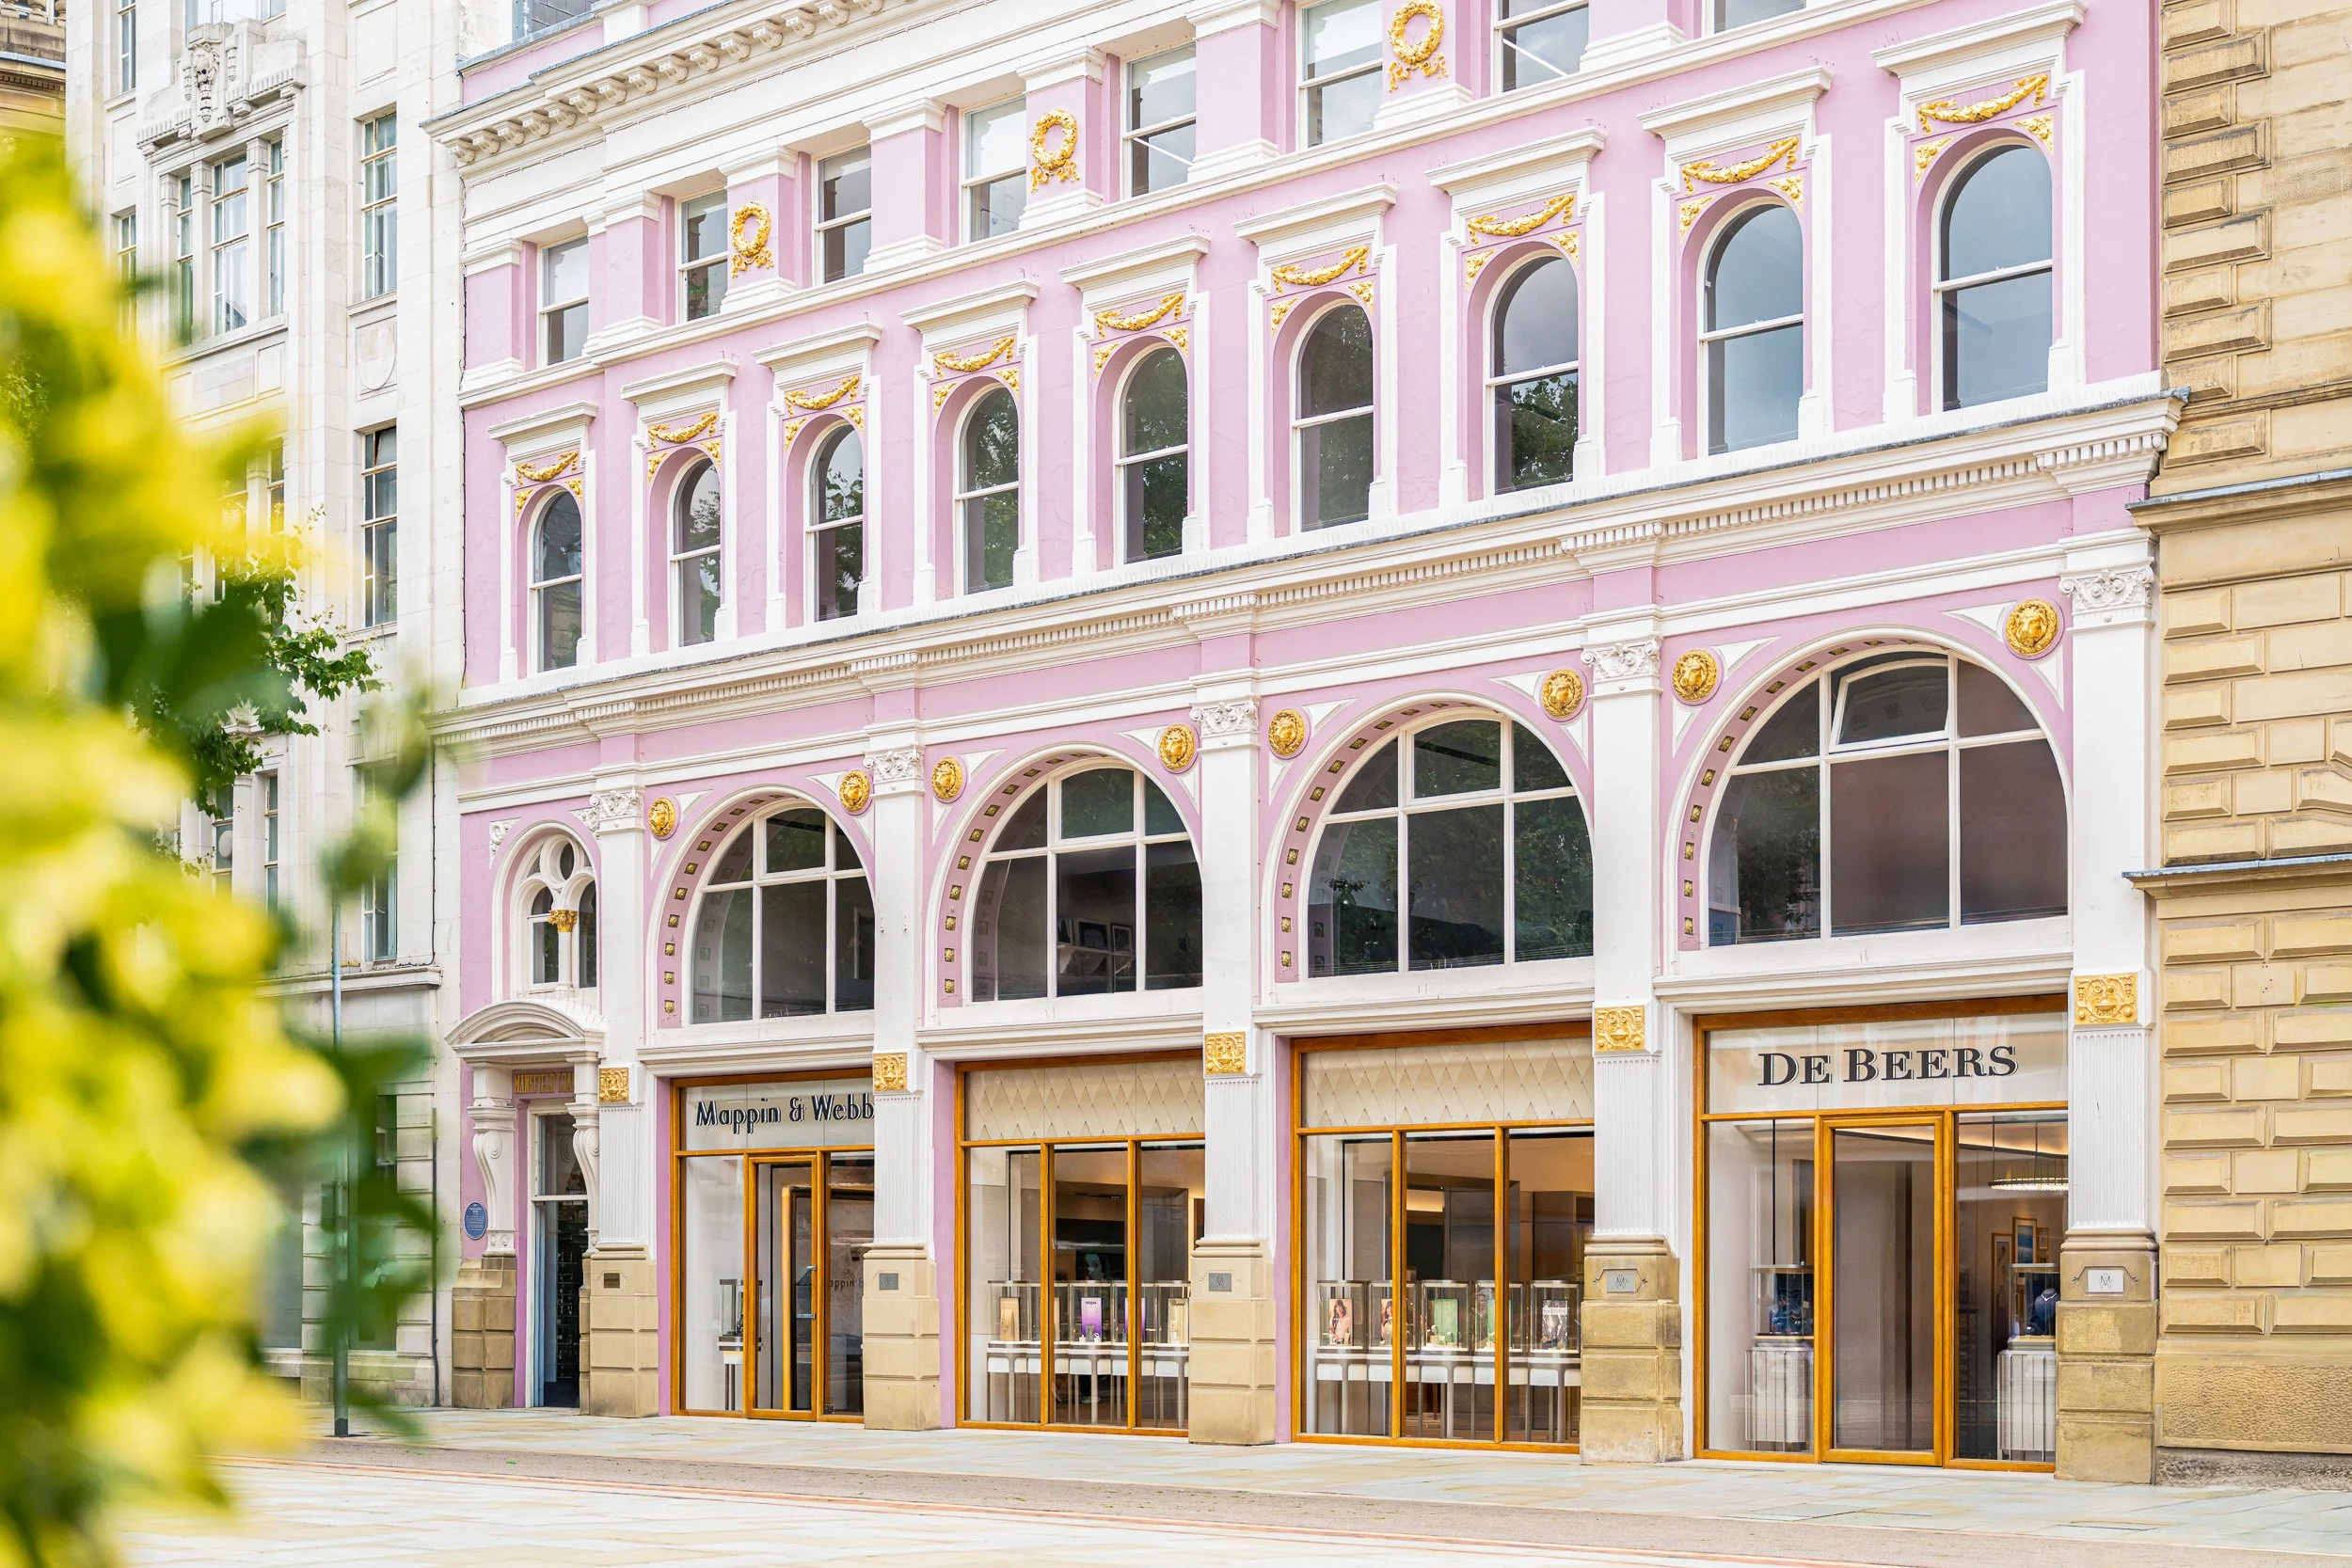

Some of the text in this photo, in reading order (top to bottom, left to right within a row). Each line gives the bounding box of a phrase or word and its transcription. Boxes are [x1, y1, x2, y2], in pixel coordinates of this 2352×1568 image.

[1757, 1045, 2019, 1086] DE BEERS
[514, 1071, 573, 1094] MANSFIELD CHA
[696, 1092, 875, 1134] Mappin & Webb
[830, 1275, 854, 1291] appin
